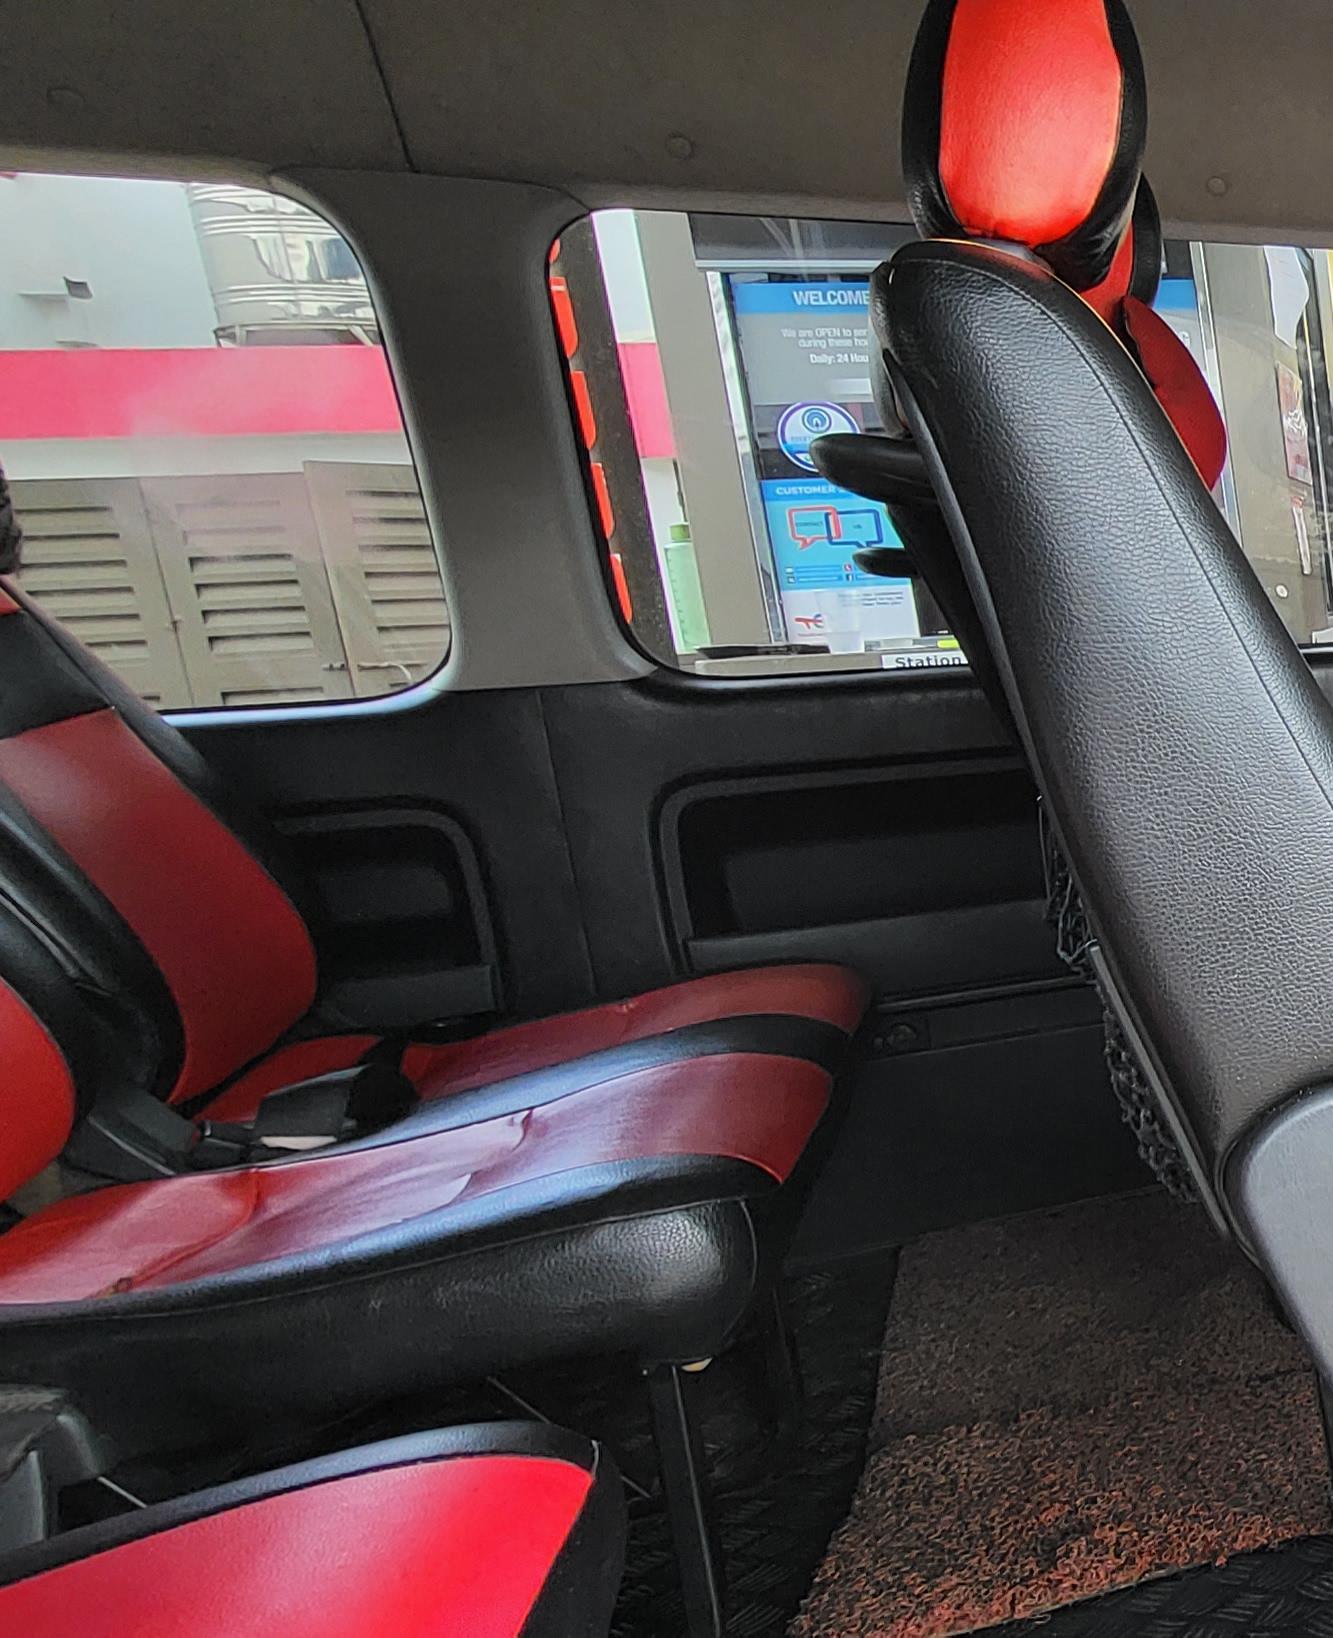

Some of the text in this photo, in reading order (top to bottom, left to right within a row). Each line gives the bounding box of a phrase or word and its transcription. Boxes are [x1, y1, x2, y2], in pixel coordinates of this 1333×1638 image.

[793, 290, 870, 306] WELCOME
[815, 328, 840, 338] OPEN
[842, 328, 852, 337] to
[798, 338, 826, 348] during
[837, 353, 849, 363] 24
[776, 485, 836, 495] CUSTOMER
[895, 655, 961, 667] Station
